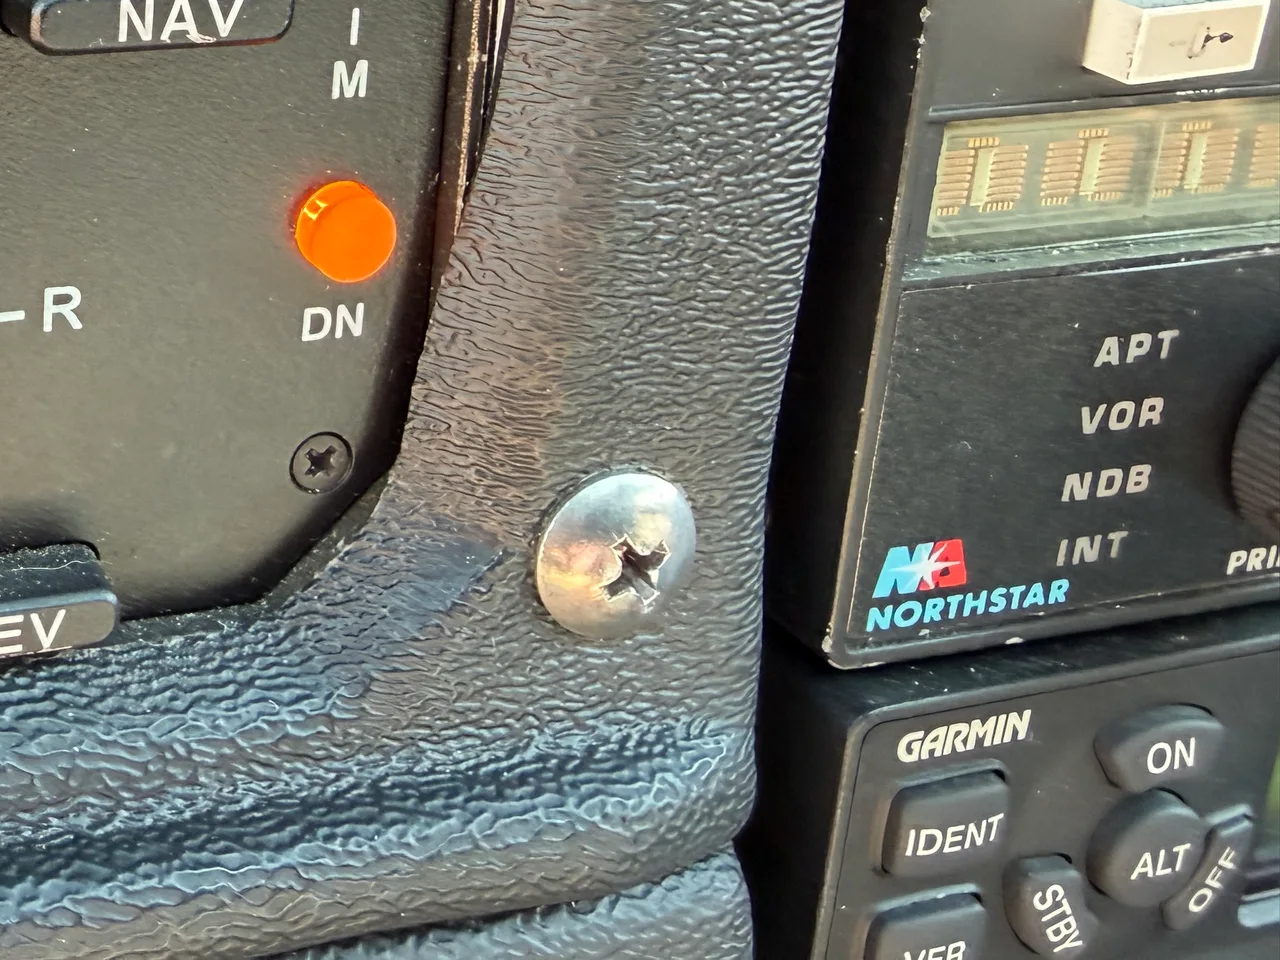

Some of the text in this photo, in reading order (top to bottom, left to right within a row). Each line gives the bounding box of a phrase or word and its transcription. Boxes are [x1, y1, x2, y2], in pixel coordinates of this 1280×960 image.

[43, 286, 83, 332] R
[301, 302, 365, 342] DN
[1093, 329, 1180, 367] APT
[1080, 396, 1165, 435] VOR
[1061, 464, 1152, 502] NDB
[1055, 530, 1129, 567] INT
[1226, 544, 1280, 576] PRI
[865, 578, 1070, 632] NORTHSTAR
[897, 709, 1032, 763] GARMIN
[1147, 738, 1196, 774] ON
[905, 813, 1005, 857] IDENT
[1130, 843, 1192, 881] ALT
[1188, 846, 1237, 913] OFF
[1033, 884, 1084, 953] STBY
